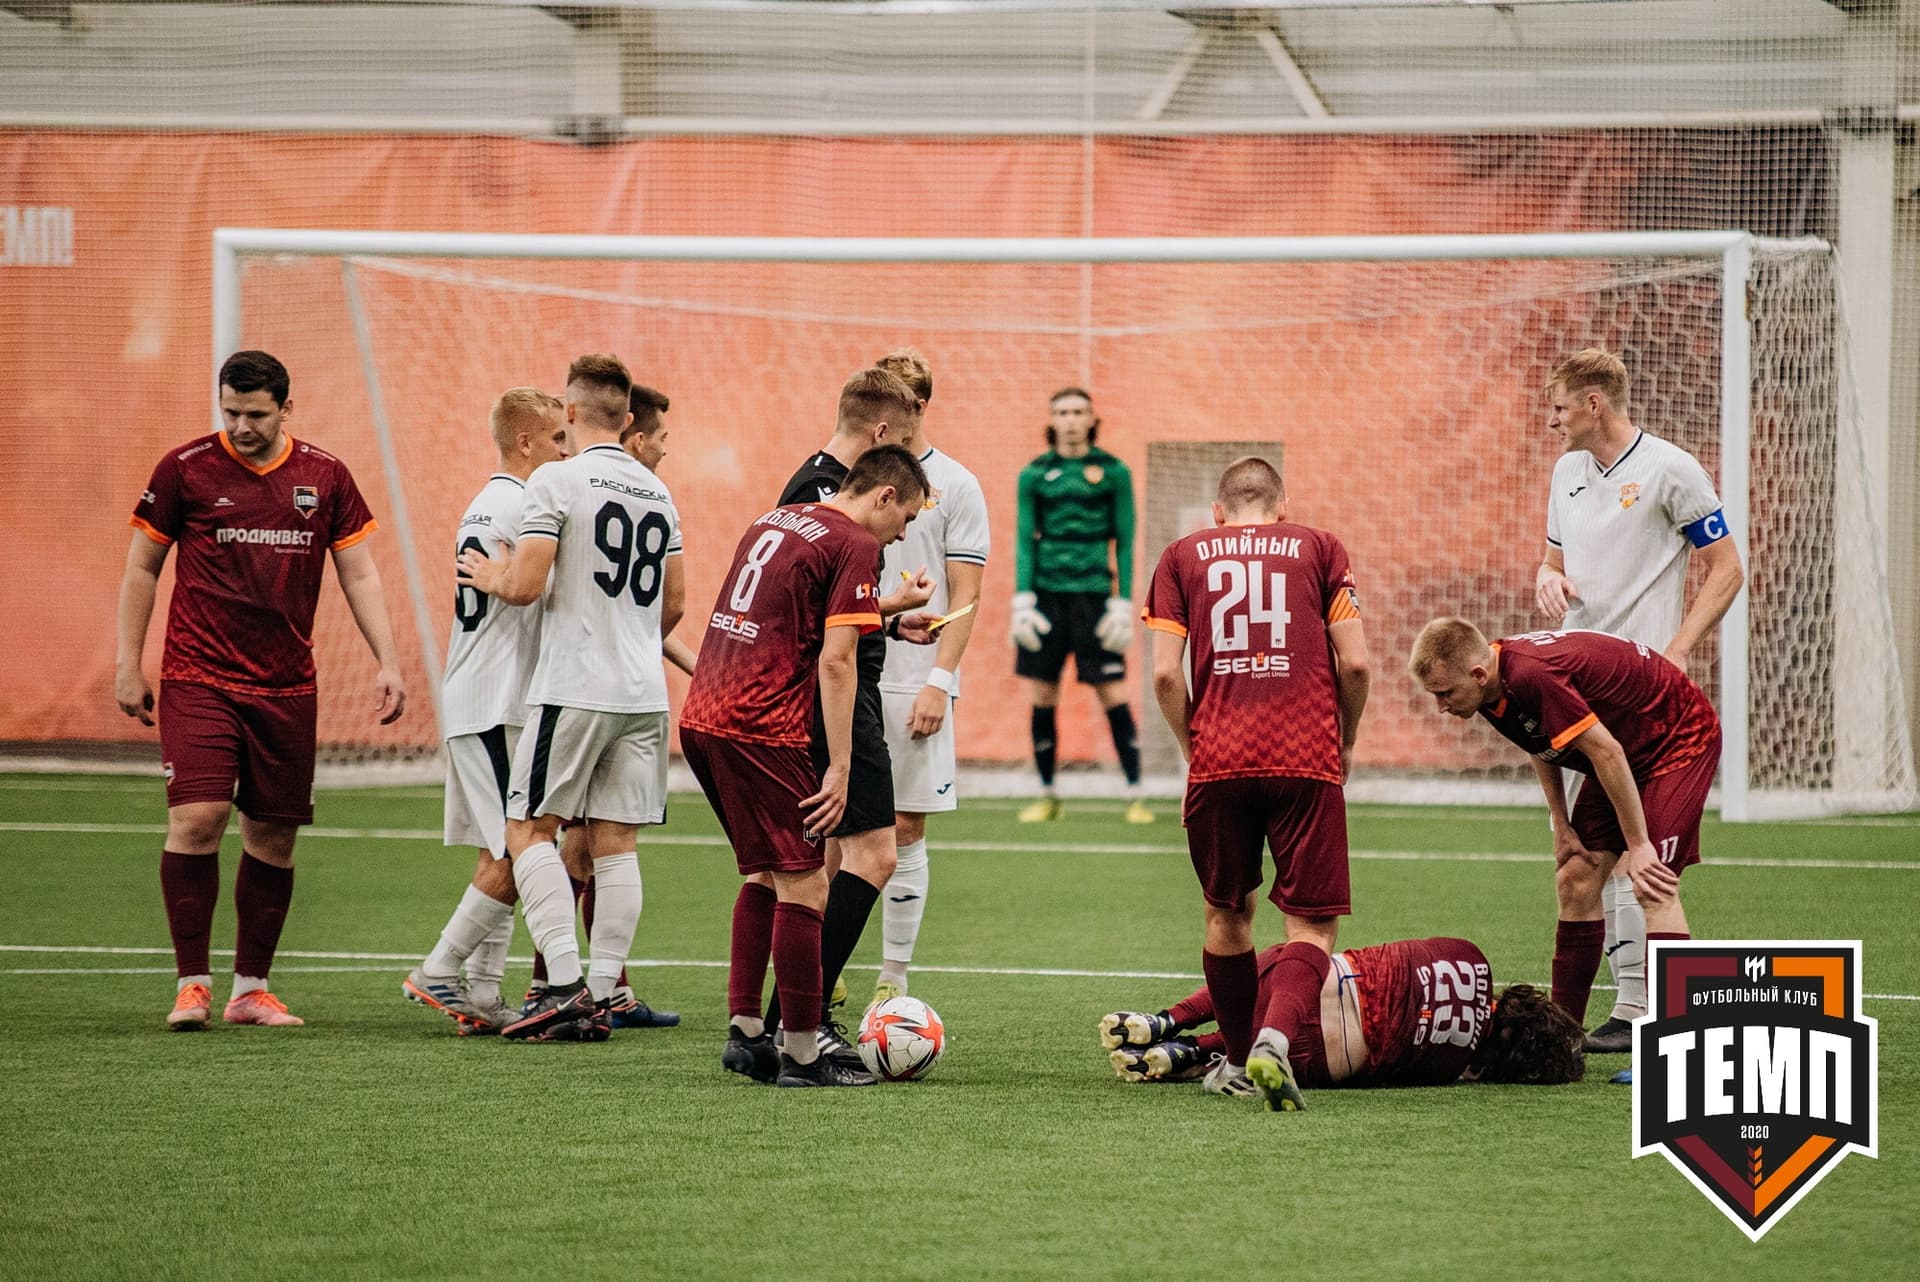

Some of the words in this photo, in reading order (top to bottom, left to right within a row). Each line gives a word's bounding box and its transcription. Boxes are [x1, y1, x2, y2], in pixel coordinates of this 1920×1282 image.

[0, 207, 73, 266] МП!
[216, 528, 314, 546] ПРОДИНВЕСТ
[1704, 515, 1723, 540] C
[593, 500, 670, 607] 98
[1196, 534, 1302, 561] ОЛИЙНЫК
[730, 529, 785, 612] 8
[1207, 560, 1291, 653] 24
[710, 612, 760, 638] SEUS
[1214, 653, 1290, 675] SEUS
[1660, 836, 1679, 863] 17
[1430, 960, 1476, 1047] 23
